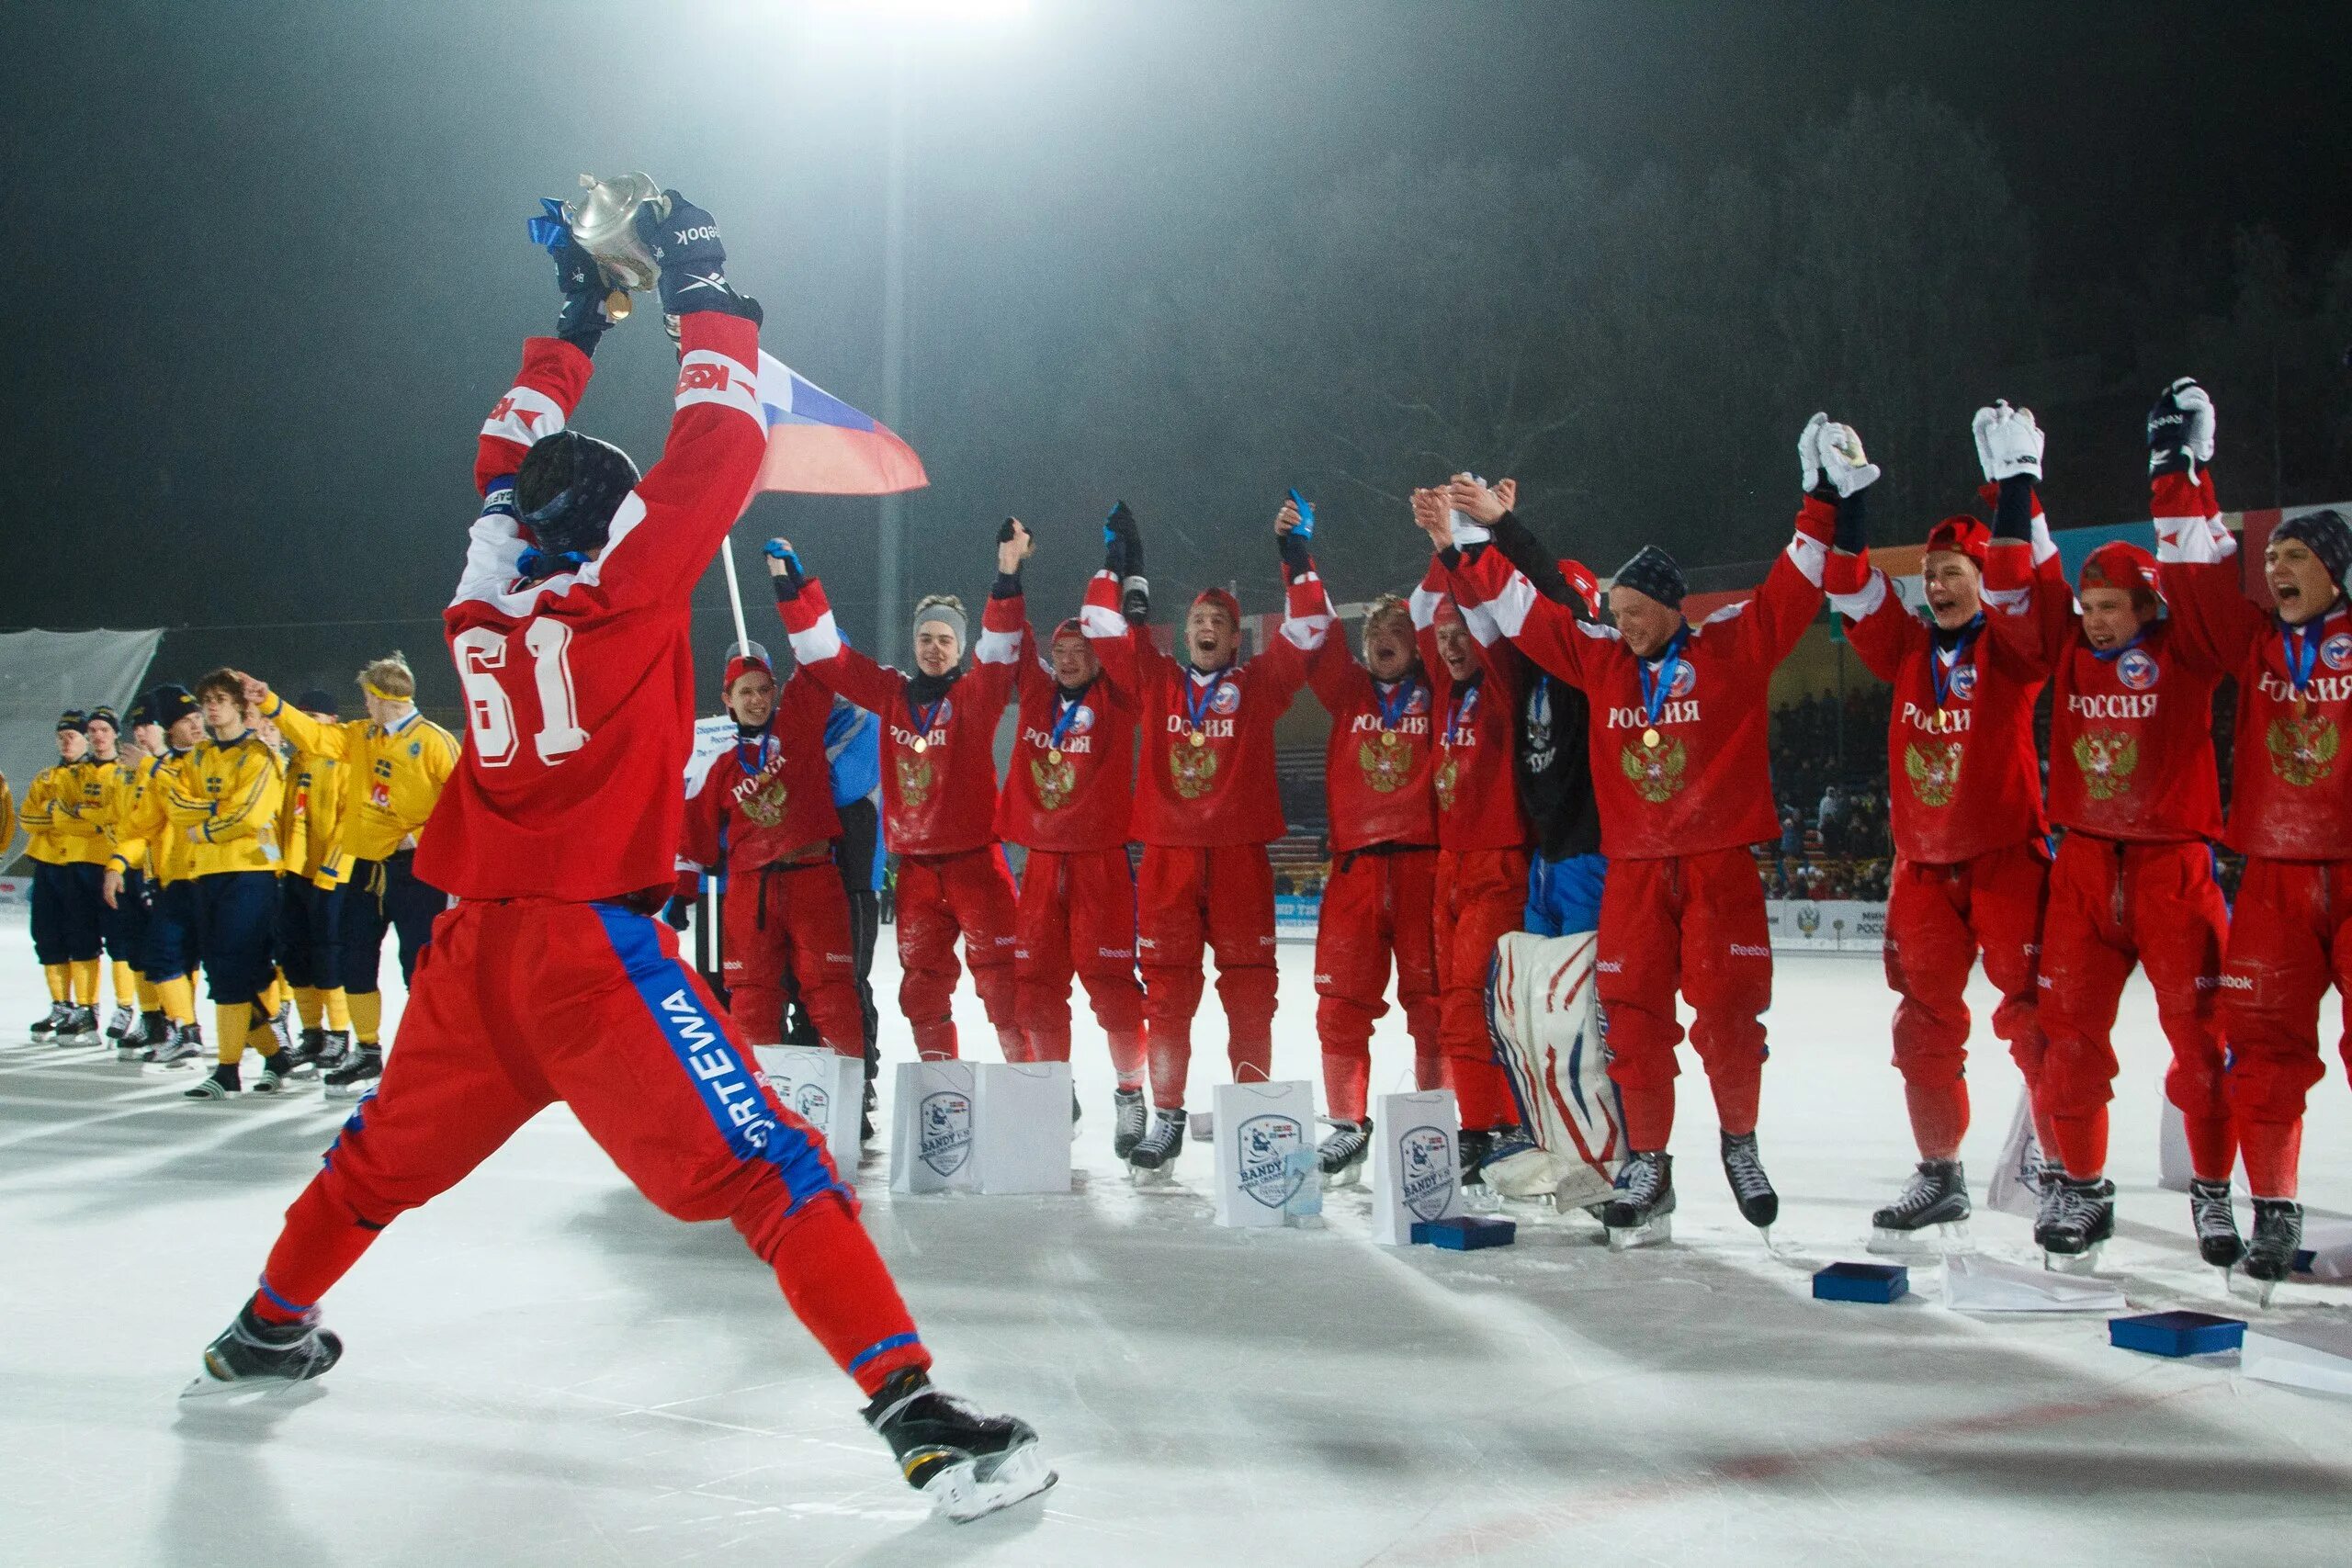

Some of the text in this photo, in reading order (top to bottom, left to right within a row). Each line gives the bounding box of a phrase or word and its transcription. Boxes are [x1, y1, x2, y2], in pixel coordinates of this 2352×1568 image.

[453, 616, 591, 768] 61
[2067, 694, 2158, 719] РОССИЯ
[1239, 1160, 1283, 1182] BANDY
